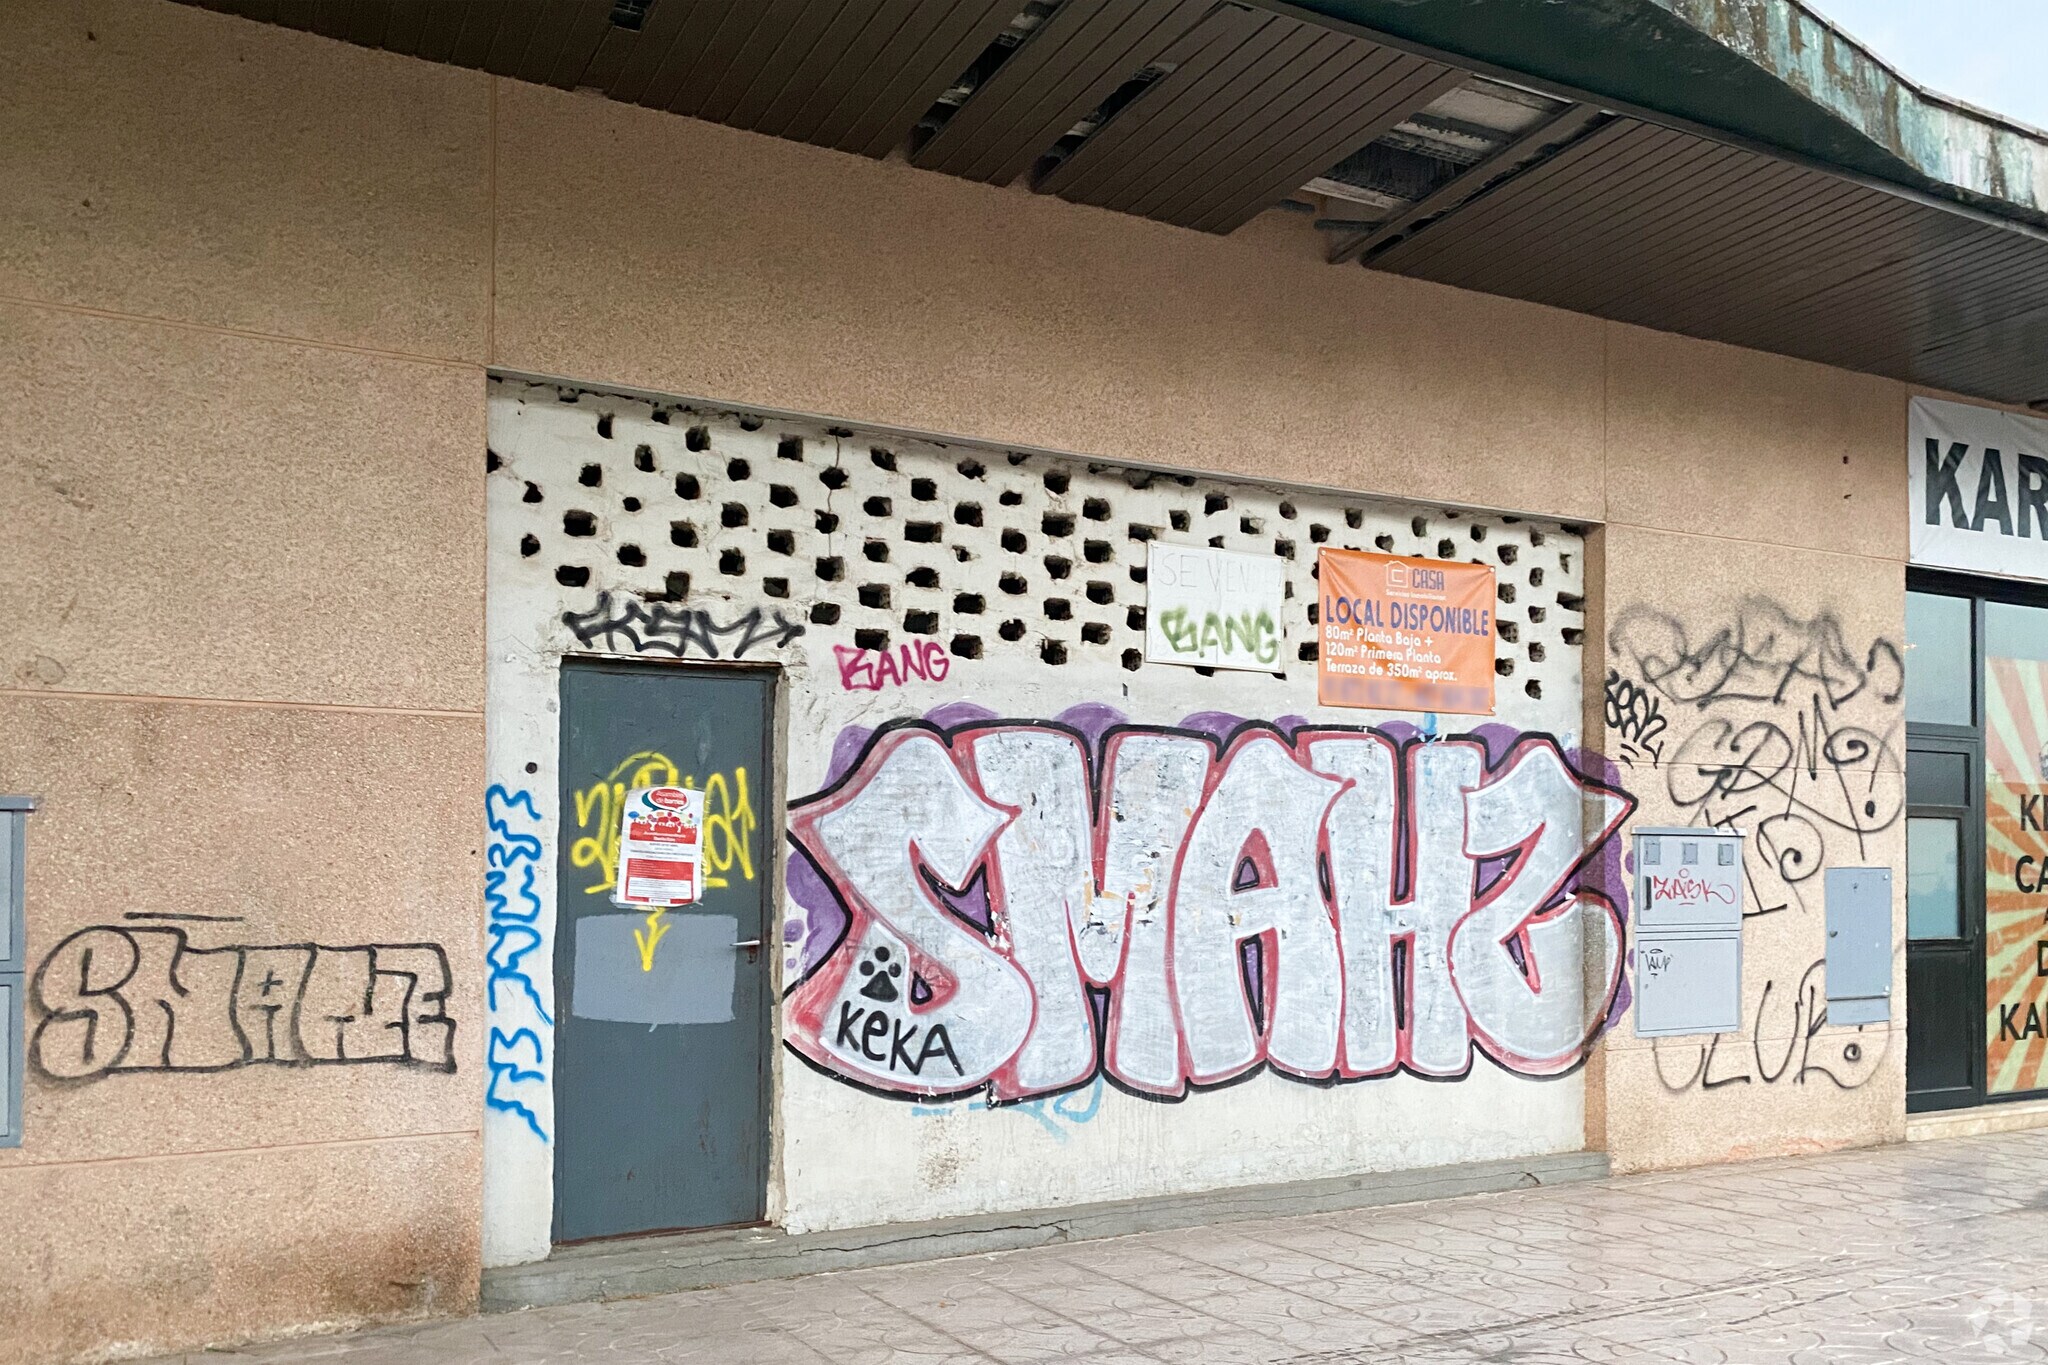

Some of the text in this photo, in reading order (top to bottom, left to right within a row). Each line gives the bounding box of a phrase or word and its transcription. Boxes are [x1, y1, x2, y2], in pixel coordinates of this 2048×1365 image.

[1926, 438, 2048, 541] KAR
[1159, 553, 1278, 596] SE VEN
[1412, 568, 1445, 591] CASA
[1326, 595, 1489, 636] LOCAL DISPONIBLE
[1357, 628, 1393, 644] Planta
[1395, 631, 1421, 649] Baja
[1425, 638, 1434, 647] +
[1361, 645, 1404, 661] Primera
[1406, 649, 1441, 664] Planta
[1326, 658, 1366, 675] Terraza
[1369, 663, 1383, 676] de
[1425, 671, 1458, 683] aprox.
[2000, 1002, 2048, 1041] KA
